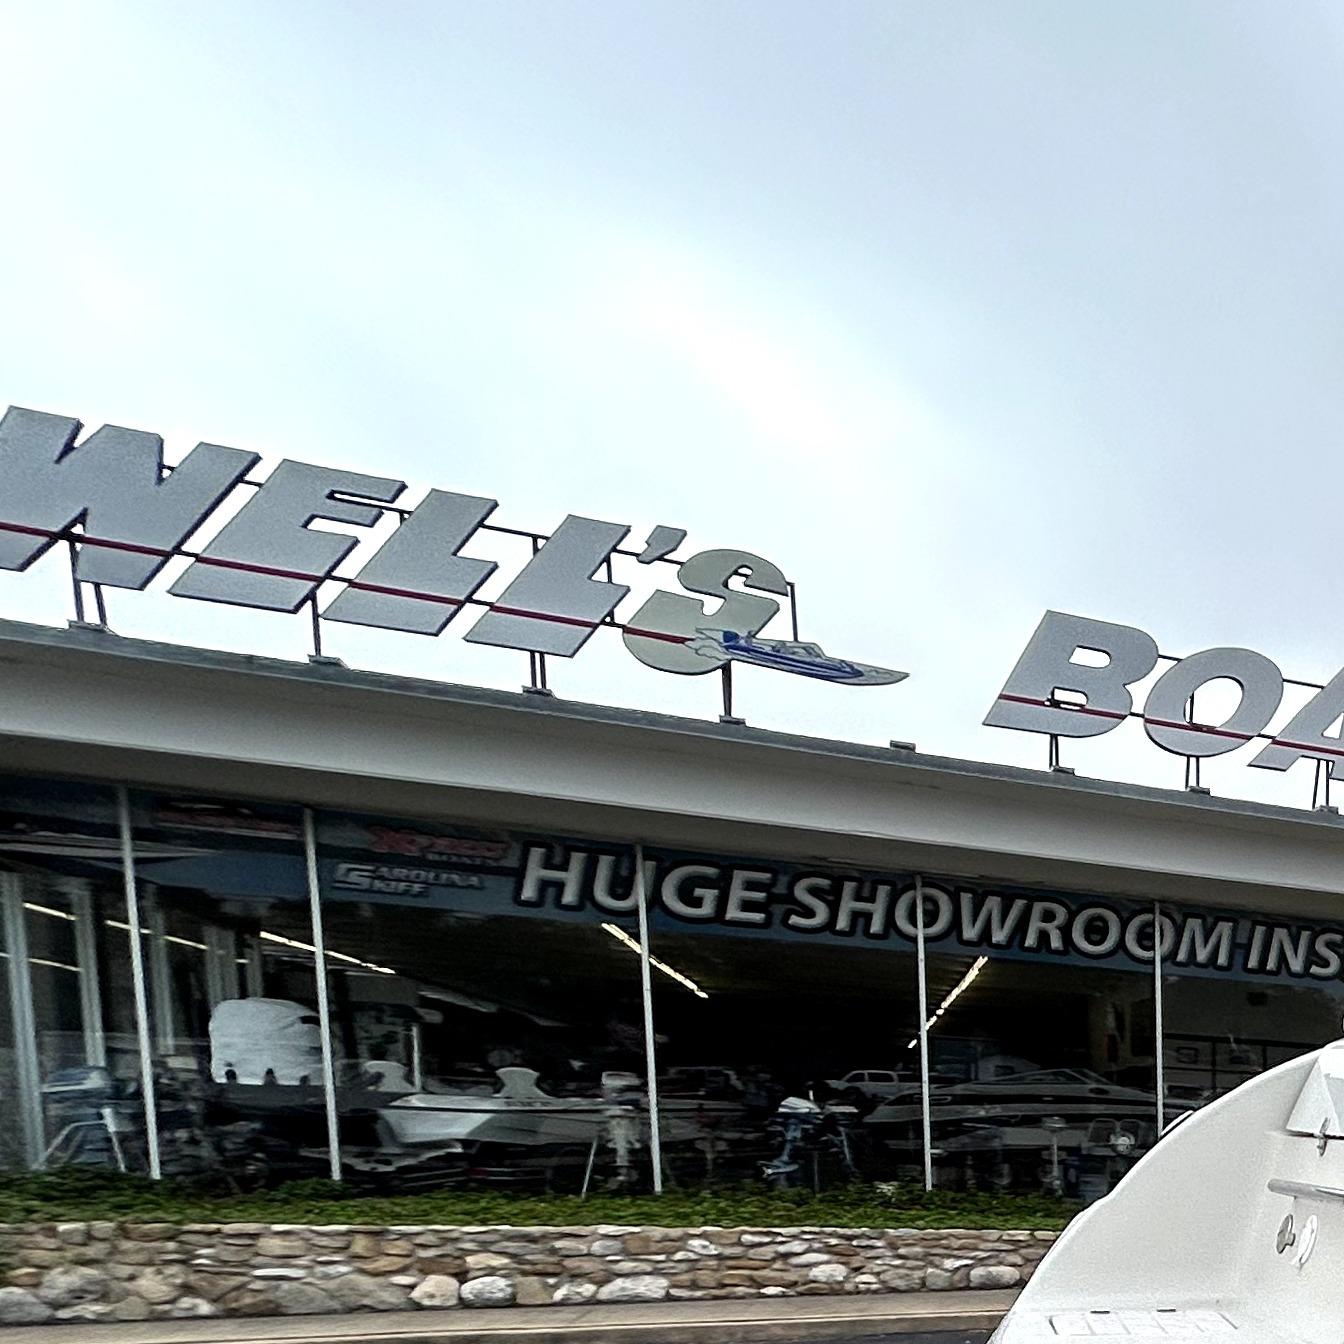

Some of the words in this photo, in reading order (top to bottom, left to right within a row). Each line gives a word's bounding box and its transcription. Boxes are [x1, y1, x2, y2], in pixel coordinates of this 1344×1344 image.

[0, 405, 790, 675] WELL'S
[519, 845, 773, 925] HUGE
[787, 876, 1234, 969] SHOWROOM
